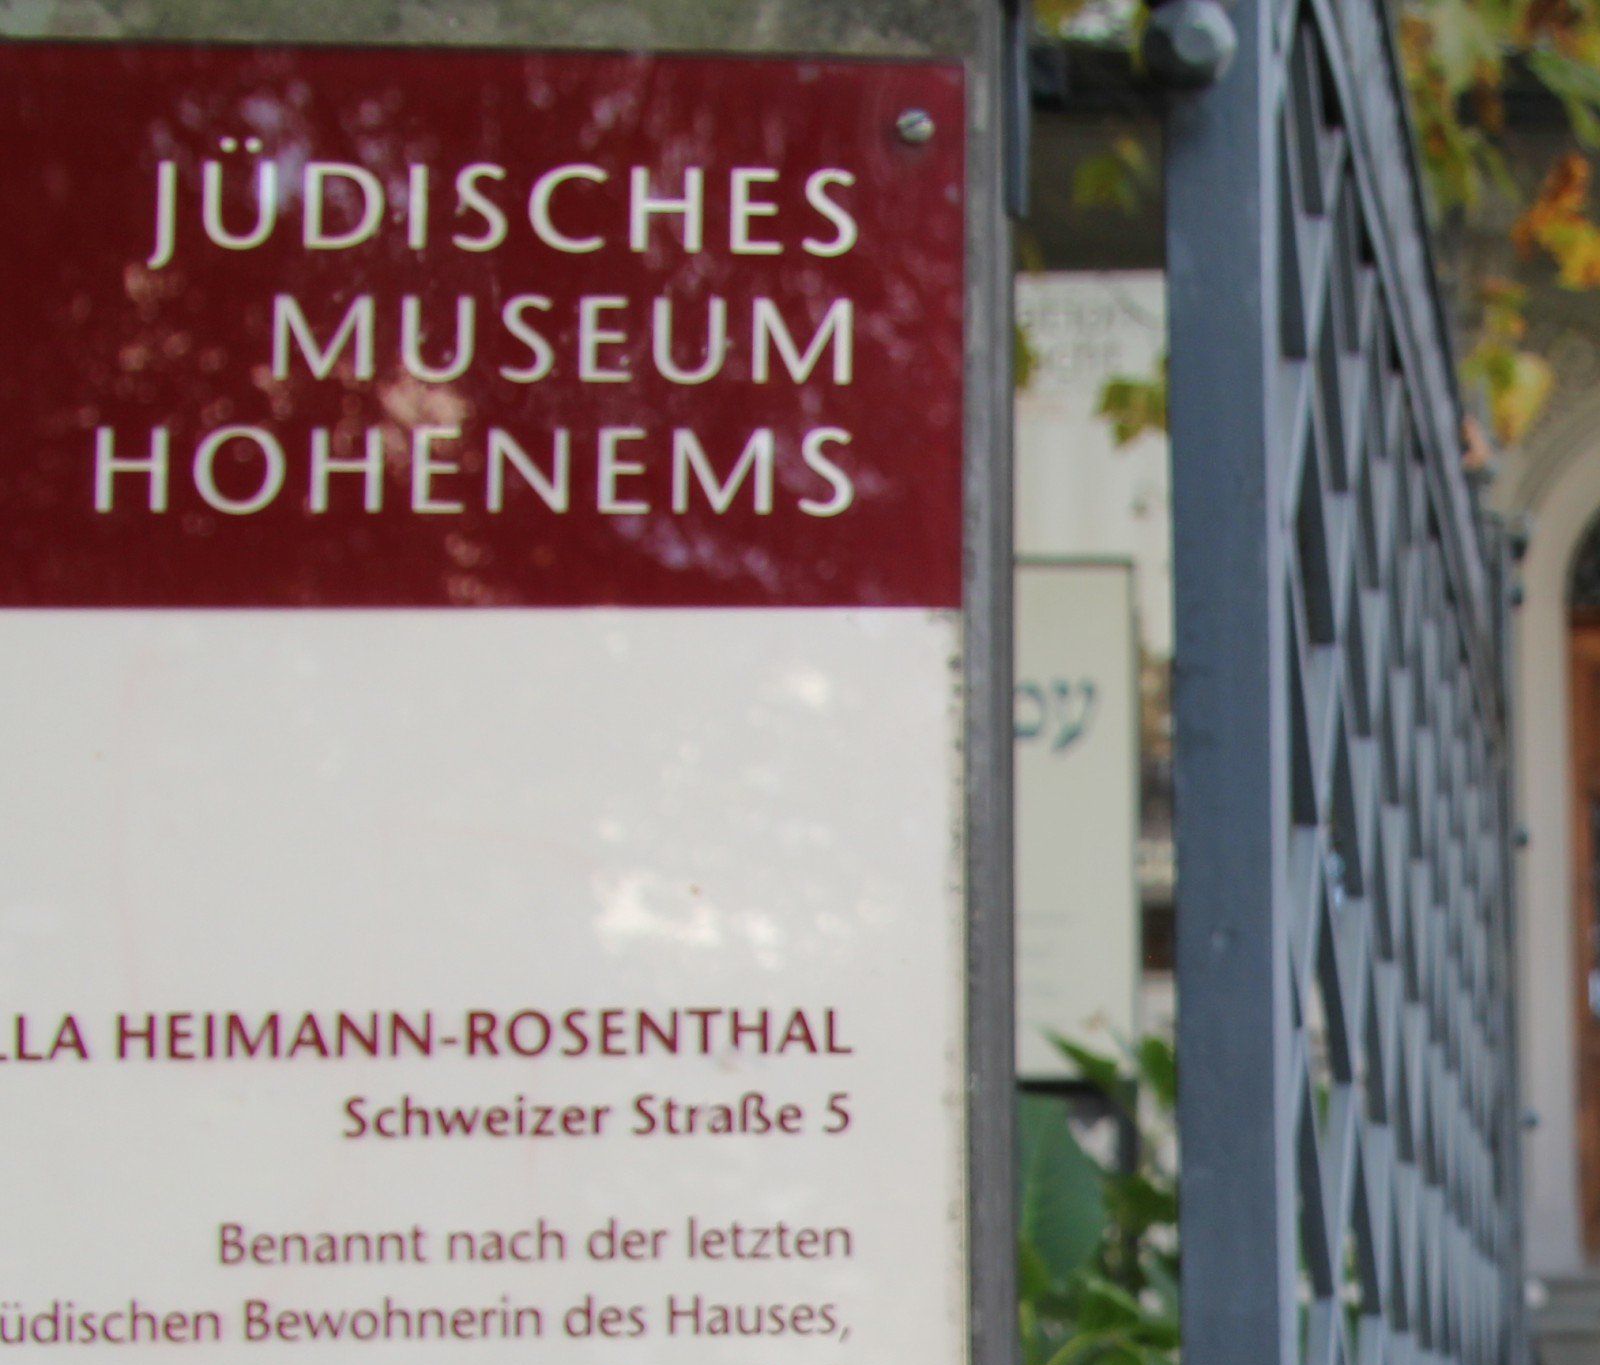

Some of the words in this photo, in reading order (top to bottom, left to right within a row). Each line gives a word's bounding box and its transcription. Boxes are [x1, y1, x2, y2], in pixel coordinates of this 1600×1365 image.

[151, 140, 856, 267] JÜDISCHES
[274, 297, 851, 384] MUSEUM
[97, 426, 852, 516] HOHENEMS
[0, 1013, 91, 1064] LA
[116, 1007, 855, 1058] HEIMANN-ROSENTHAL
[343, 1094, 613, 1140] Schweizer
[632, 1091, 805, 1137] Straße
[824, 1092, 852, 1135] 5
[219, 1222, 427, 1266] Benannt
[448, 1218, 568, 1263] nach
[586, 1218, 668, 1262] der
[688, 1216, 853, 1261] letzten
[244, 1296, 544, 1343] Bewohnerin
[563, 1294, 648, 1338] des
[667, 1295, 850, 1340] Hauses,
